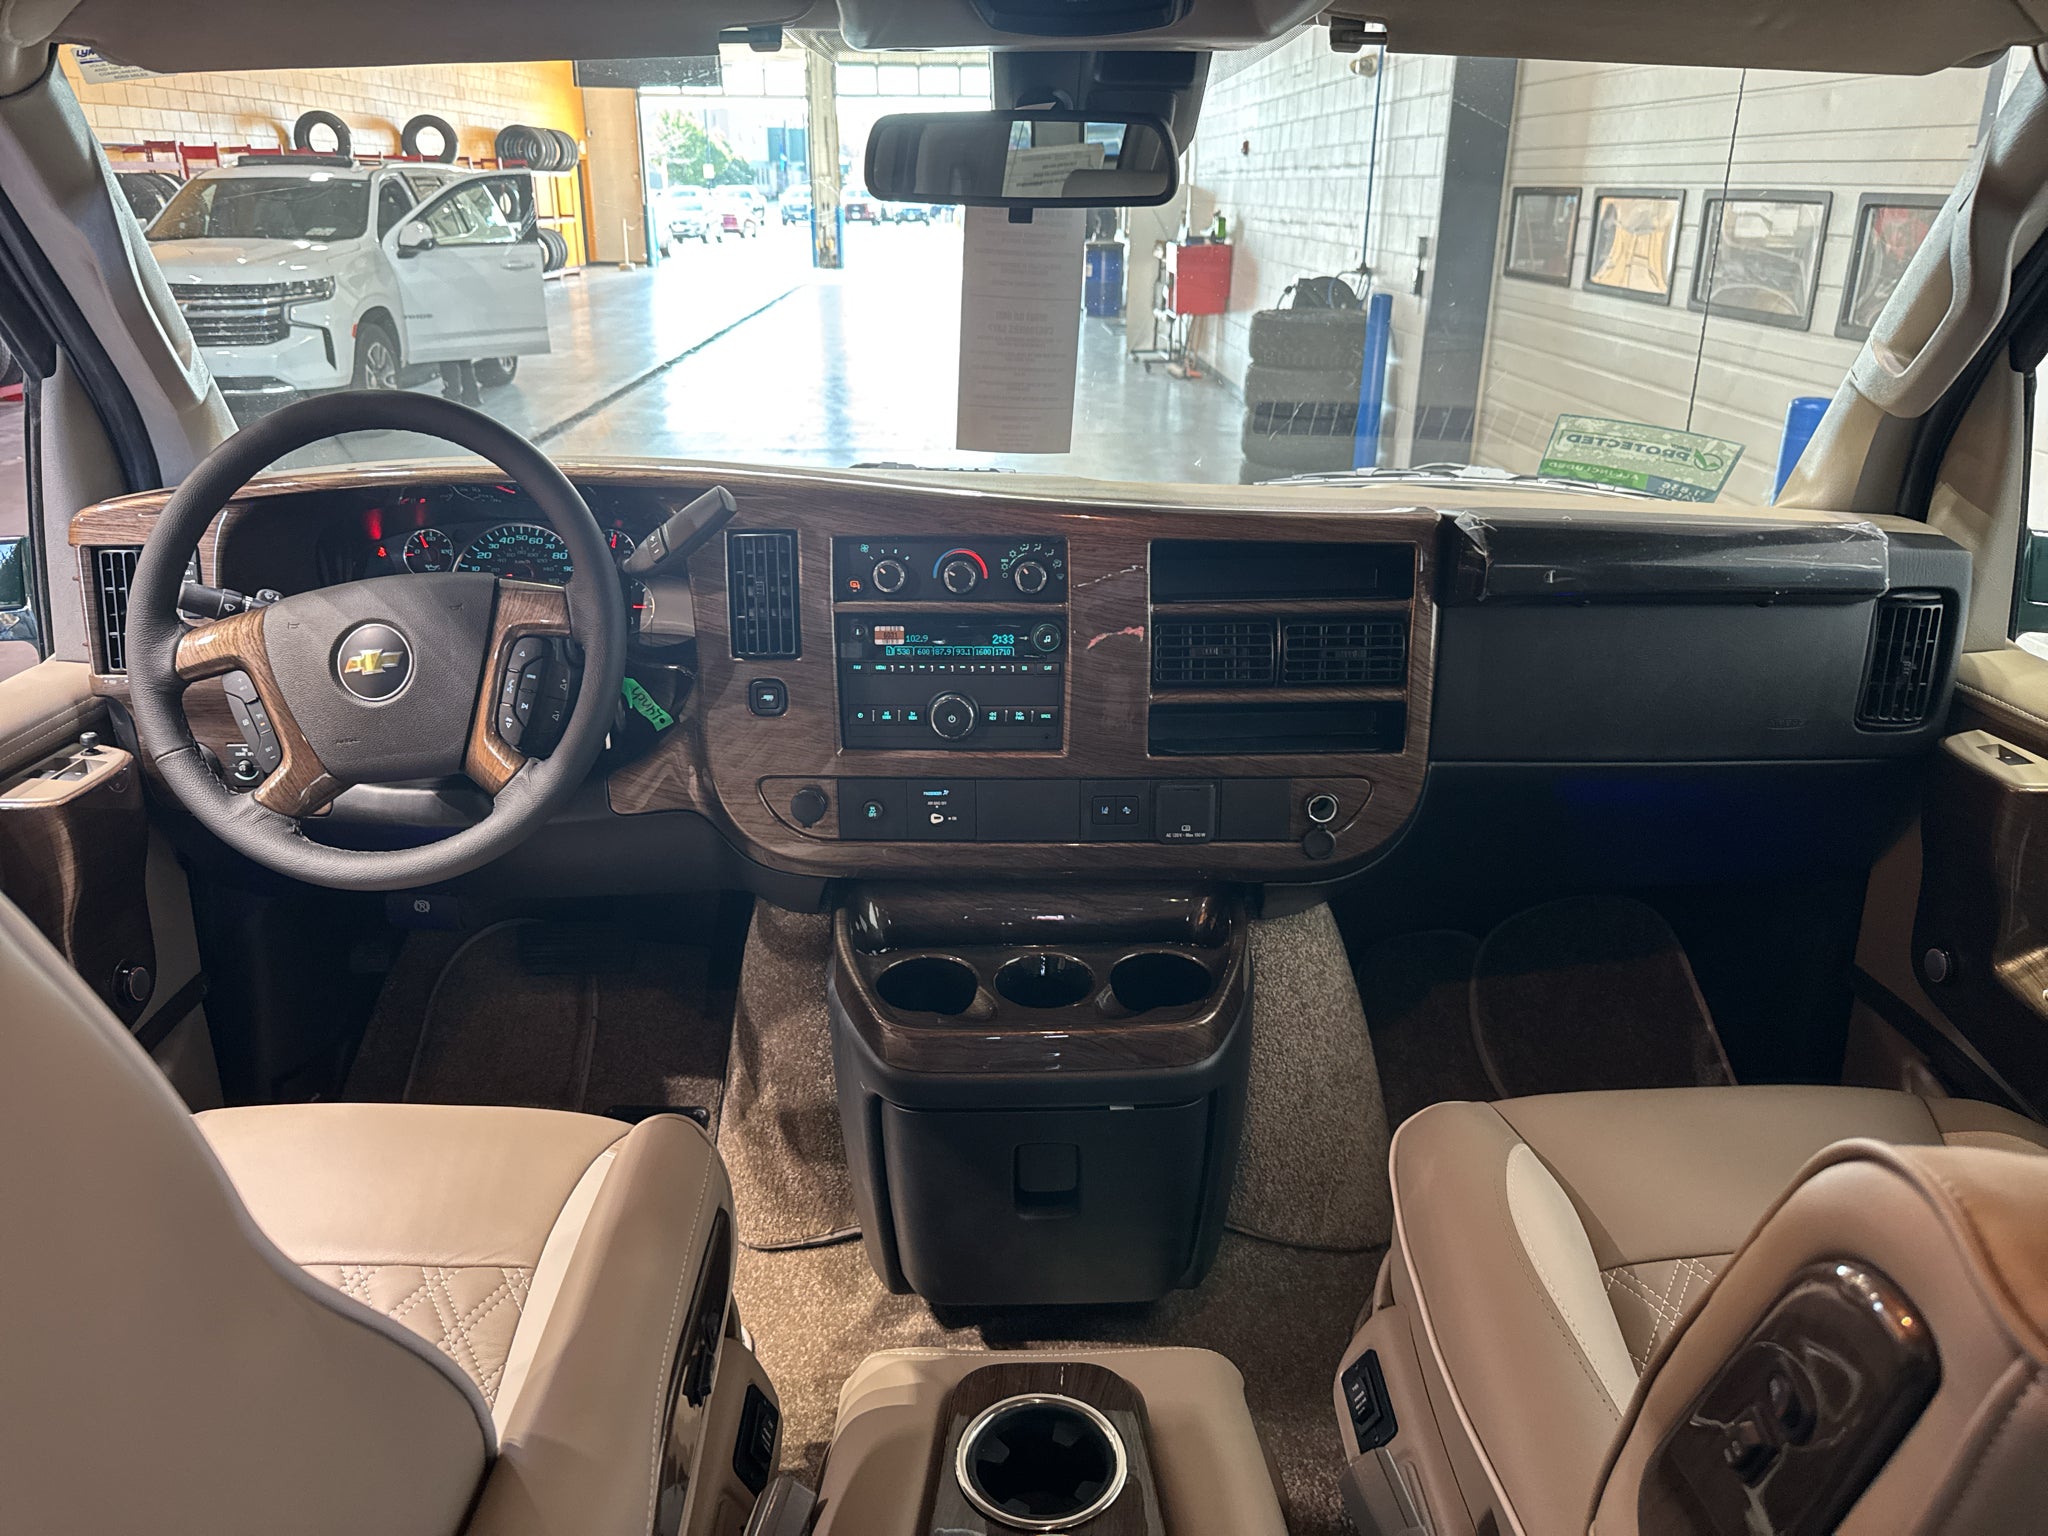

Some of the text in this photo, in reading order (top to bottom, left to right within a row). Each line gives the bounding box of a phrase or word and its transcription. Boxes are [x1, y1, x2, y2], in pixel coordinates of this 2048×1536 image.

[499, 536, 515, 544] 40
[528, 537, 544, 545] 60
[476, 551, 492, 559] 20
[551, 552, 568, 560] 80
[905, 634, 929, 643] 102.9
[992, 634, 1015, 645] 2:33
[955, 648, 971, 656] 93.1
[975, 648, 991, 656] 1600
[995, 648, 1011, 656] 1710
[632, 686, 664, 720] Lynch
